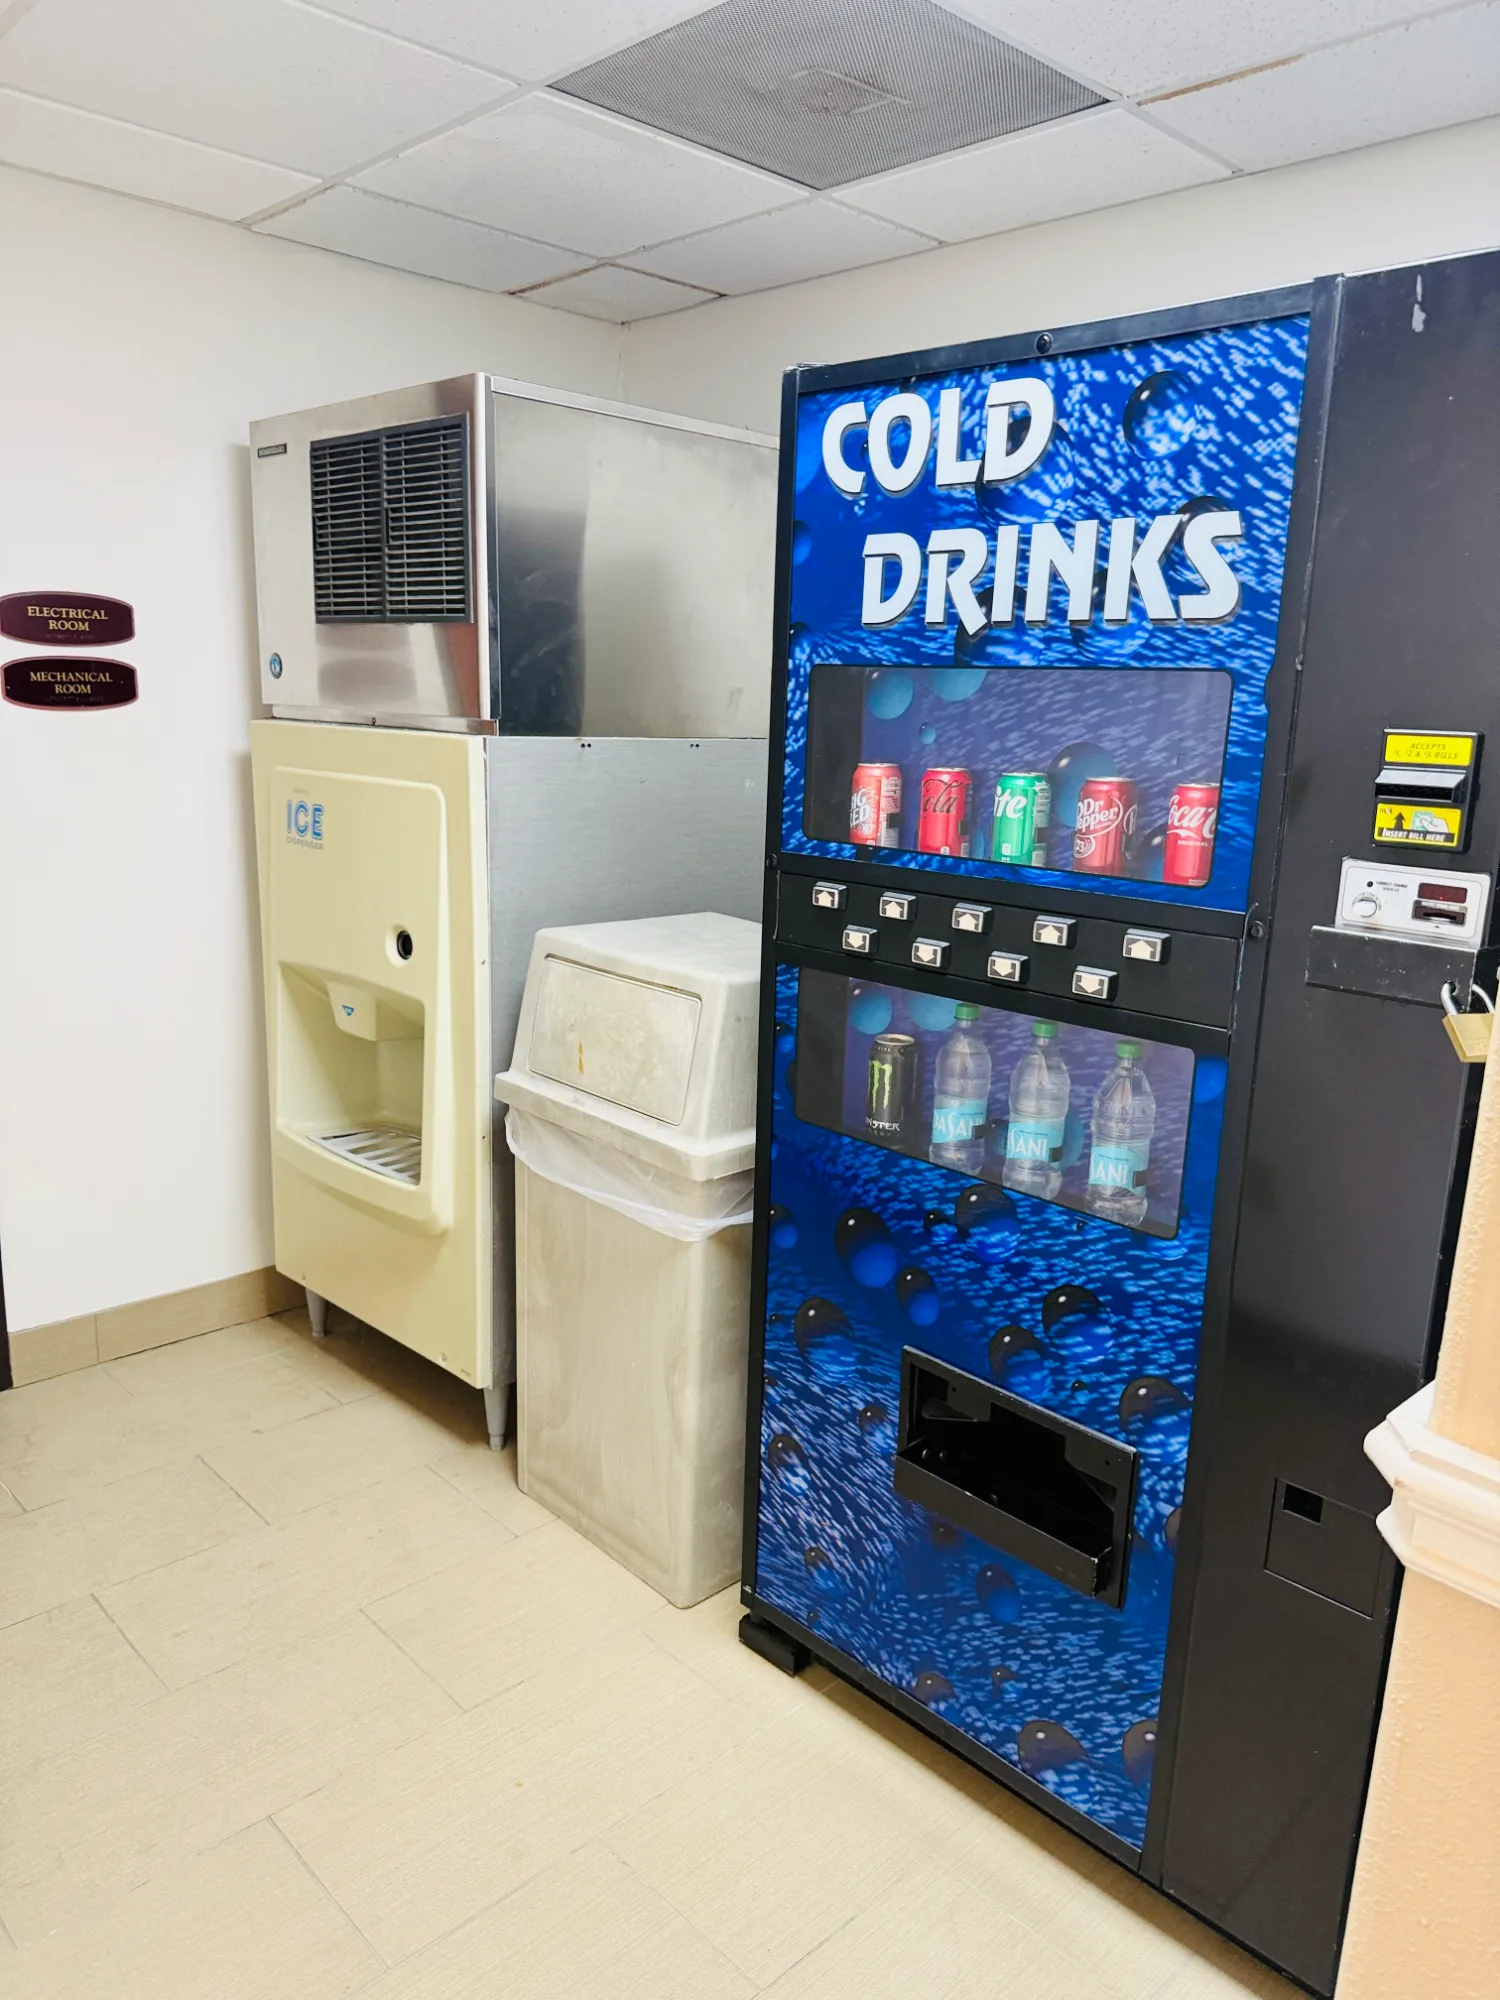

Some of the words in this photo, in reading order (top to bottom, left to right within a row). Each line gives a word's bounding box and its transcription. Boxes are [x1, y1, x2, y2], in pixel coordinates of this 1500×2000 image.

[822, 377, 1057, 494] COLD
[862, 510, 1244, 637] DRINKS
[27, 606, 108, 619] ELECTRICAL
[48, 620, 90, 631] ROOM
[30, 672, 113, 682] MECHANICAL
[55, 684, 92, 694] ROOM
[286, 799, 324, 840] ICE
[1382, 827, 1408, 839] INSERT
[1408, 831, 1424, 840] BILL
